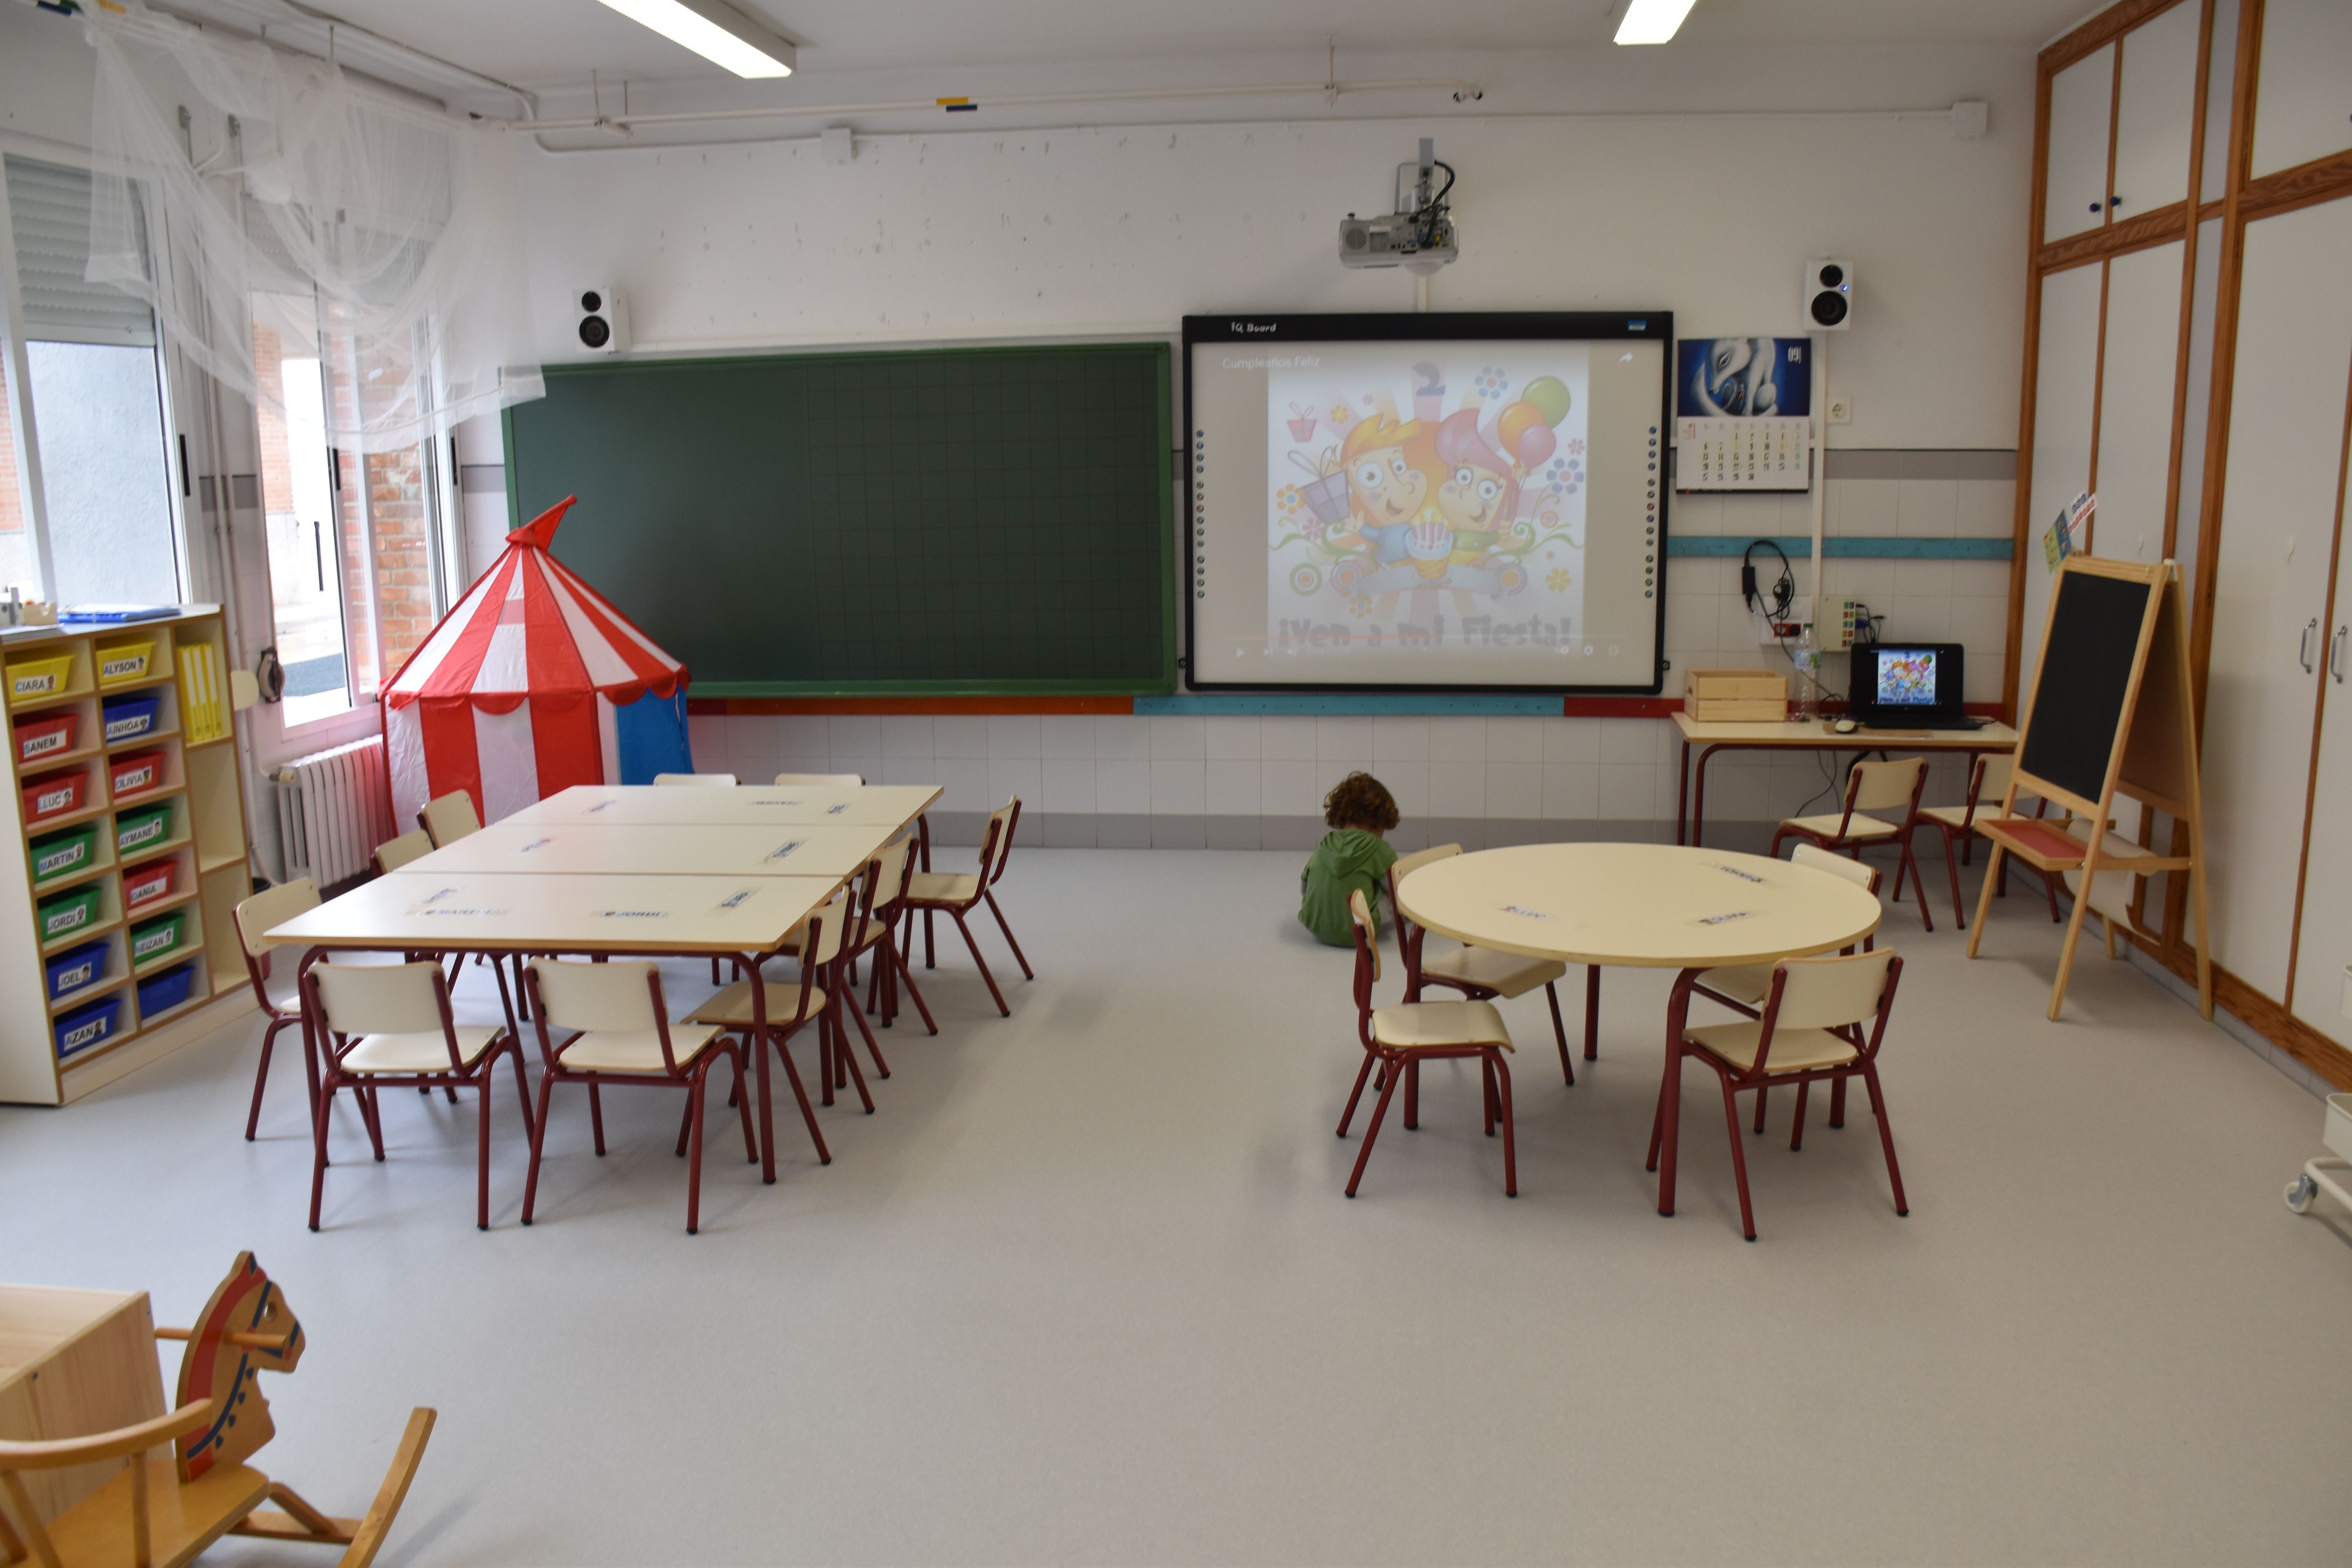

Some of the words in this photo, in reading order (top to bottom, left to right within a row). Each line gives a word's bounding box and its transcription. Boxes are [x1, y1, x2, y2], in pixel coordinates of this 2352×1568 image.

[1231, 322, 1243, 333] IQ
[1247, 322, 1277, 332] Board
[1295, 355, 1320, 367] Feliz
[1413, 362, 1446, 396] 2
[1368, 624, 1382, 647] a
[104, 661, 137, 675] ALYSON
[15, 679, 45, 693] CIARA
[107, 721, 139, 735] AINHOA
[24, 735, 57, 755] SANEM
[116, 774, 142, 790] OLIVIA
[39, 794, 61, 809] LLUC
[120, 826, 153, 846] AYMANE
[40, 851, 74, 870] MARTIN
[131, 884, 156, 902] DANIA
[48, 913, 76, 931] JORDI
[135, 936, 164, 953] NEIZAN
[59, 971, 82, 987] JOEL
[65, 1025, 94, 1047] AZAN
